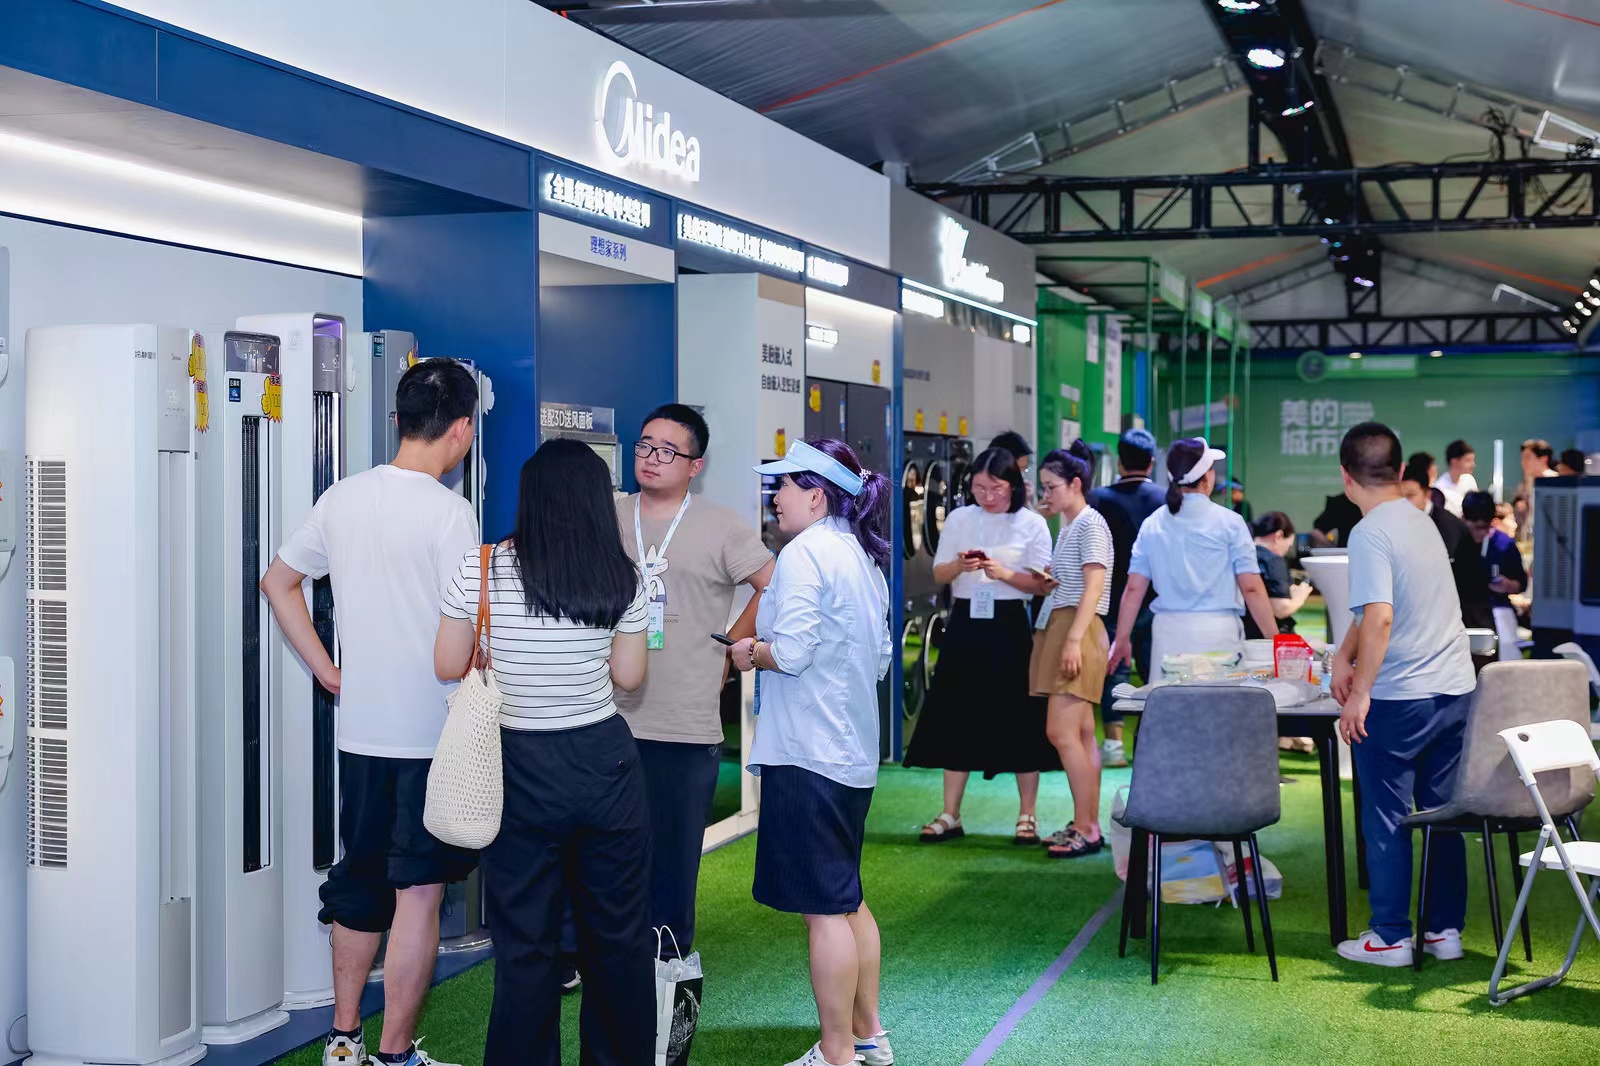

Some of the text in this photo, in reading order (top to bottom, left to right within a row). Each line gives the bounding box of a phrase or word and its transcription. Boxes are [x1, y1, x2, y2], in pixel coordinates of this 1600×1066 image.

[595, 60, 700, 182] Midea
[590, 235, 627, 262] 理想家系列
[761, 343, 793, 367] 美的嵌入式
[1281, 399, 1340, 427] 美的
